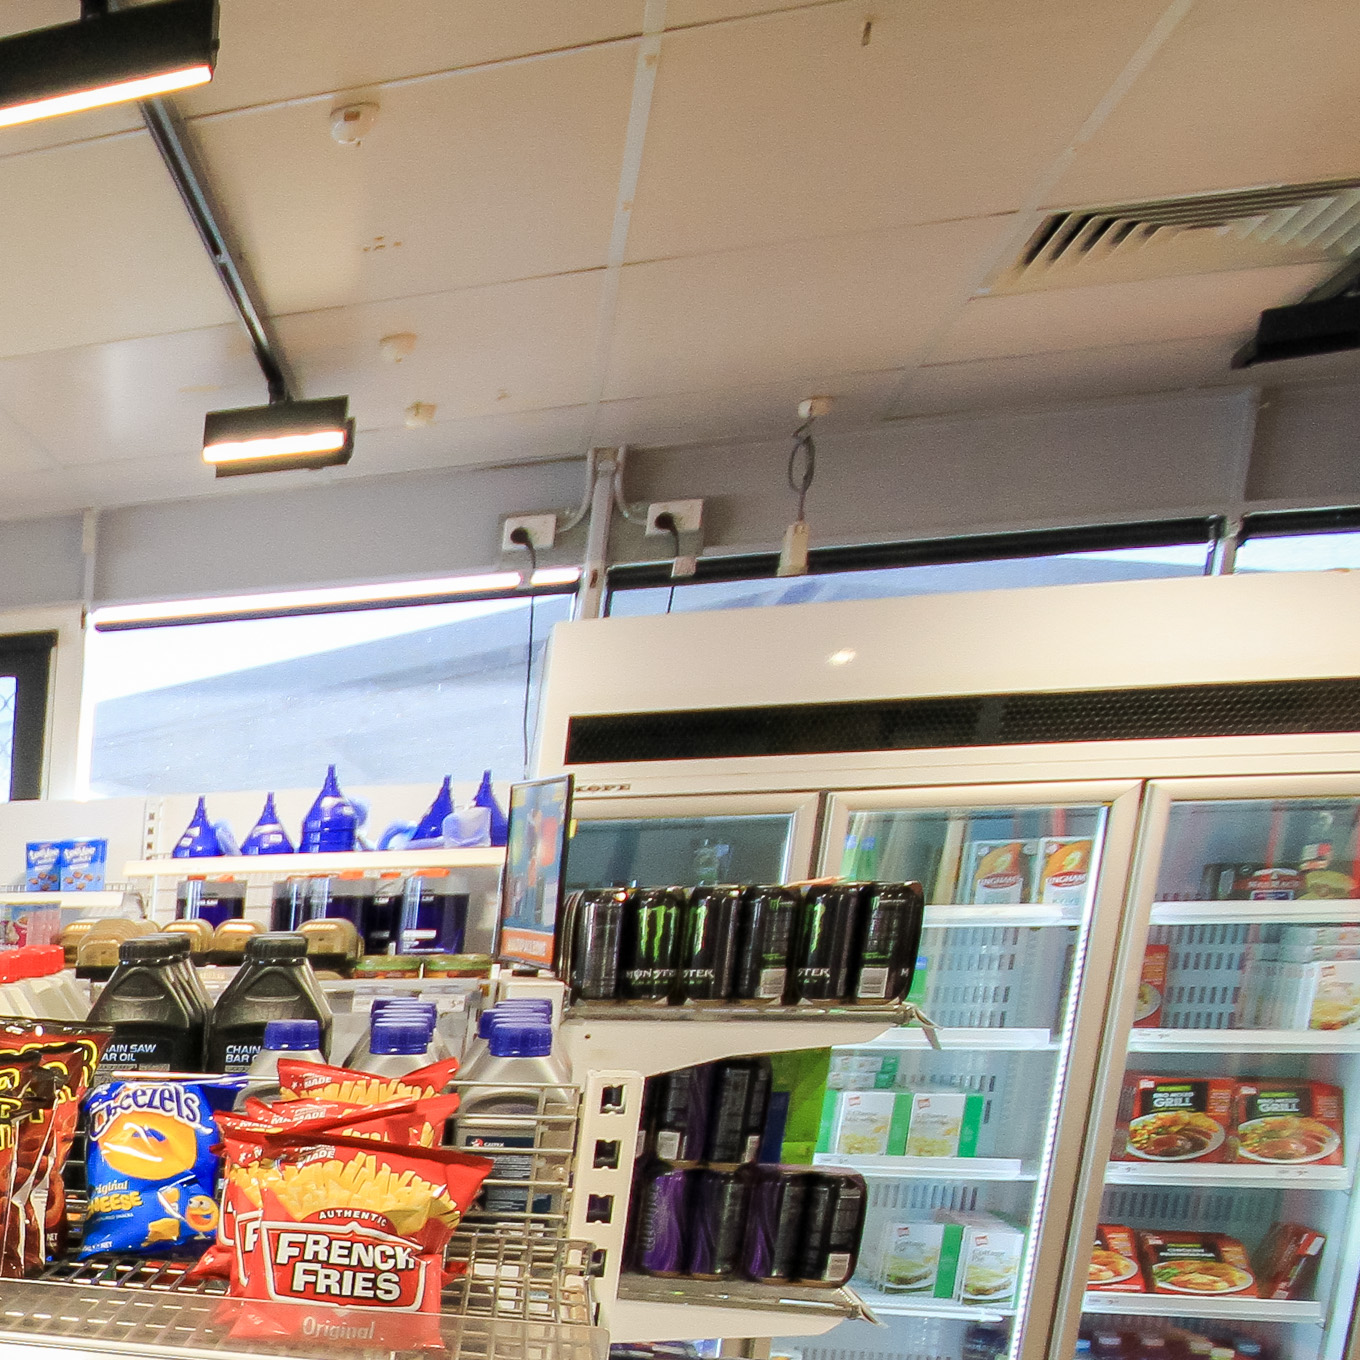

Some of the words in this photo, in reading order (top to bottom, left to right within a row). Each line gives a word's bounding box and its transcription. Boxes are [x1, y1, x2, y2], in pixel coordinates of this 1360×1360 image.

[130, 1043, 157, 1054] SAW
[225, 1045, 261, 1056] CHAIN
[118, 1053, 136, 1062] OIL
[225, 1053, 250, 1064] BAR
[1153, 1097, 1192, 1108] GRILL
[1259, 1103, 1300, 1112] GRILL
[318, 1208, 388, 1227] AUTHENTIC
[274, 1232, 416, 1270] FRENCH
[291, 1262, 403, 1301] FRIES
[301, 1314, 375, 1339] Original
